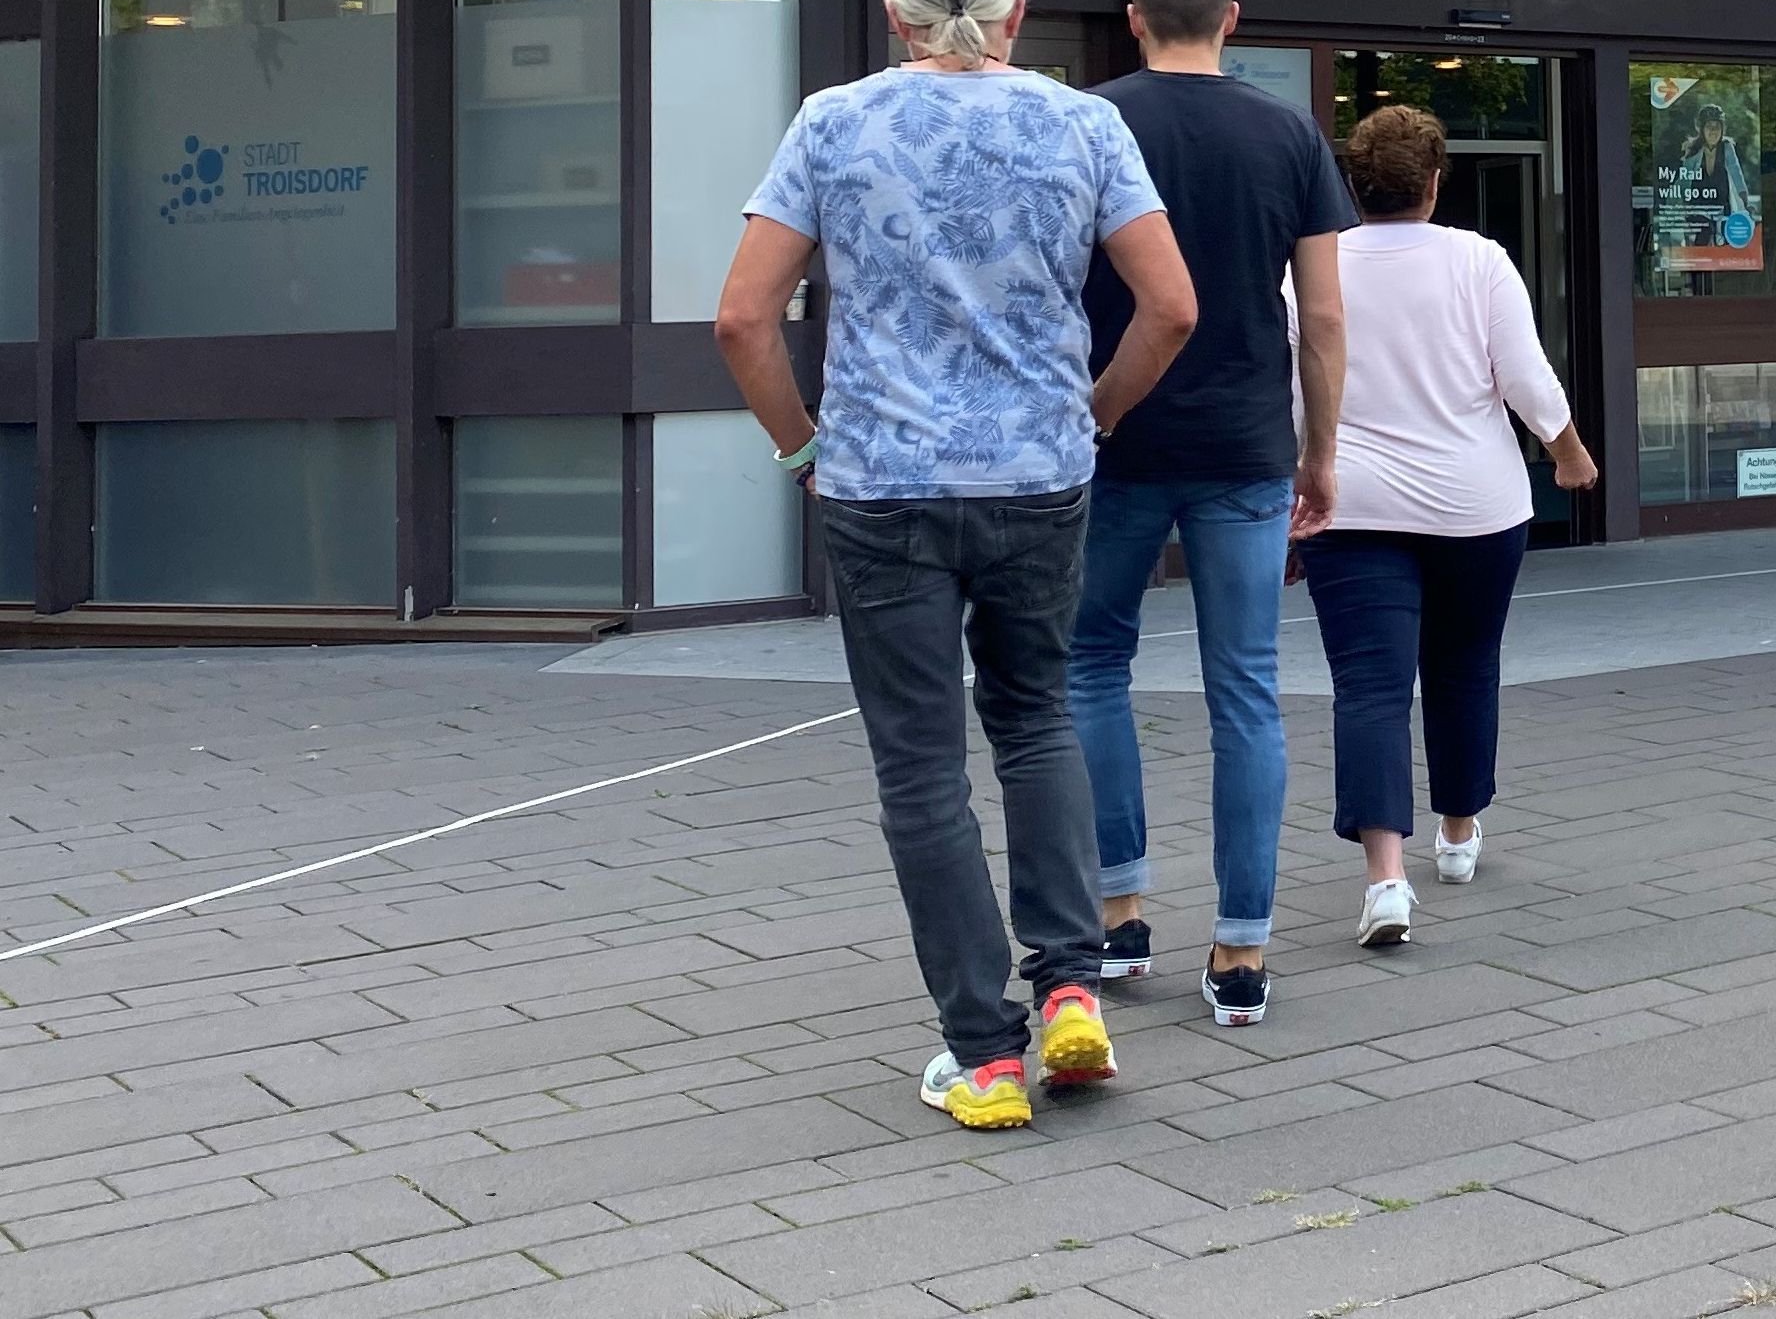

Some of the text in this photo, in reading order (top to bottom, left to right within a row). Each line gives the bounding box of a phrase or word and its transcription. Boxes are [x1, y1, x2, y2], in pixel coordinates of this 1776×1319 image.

[243, 142, 301, 167] STADT
[243, 166, 369, 196] TROISDORF
[1658, 167, 1703, 183] My Rad
[1659, 185, 1717, 201] will go on
